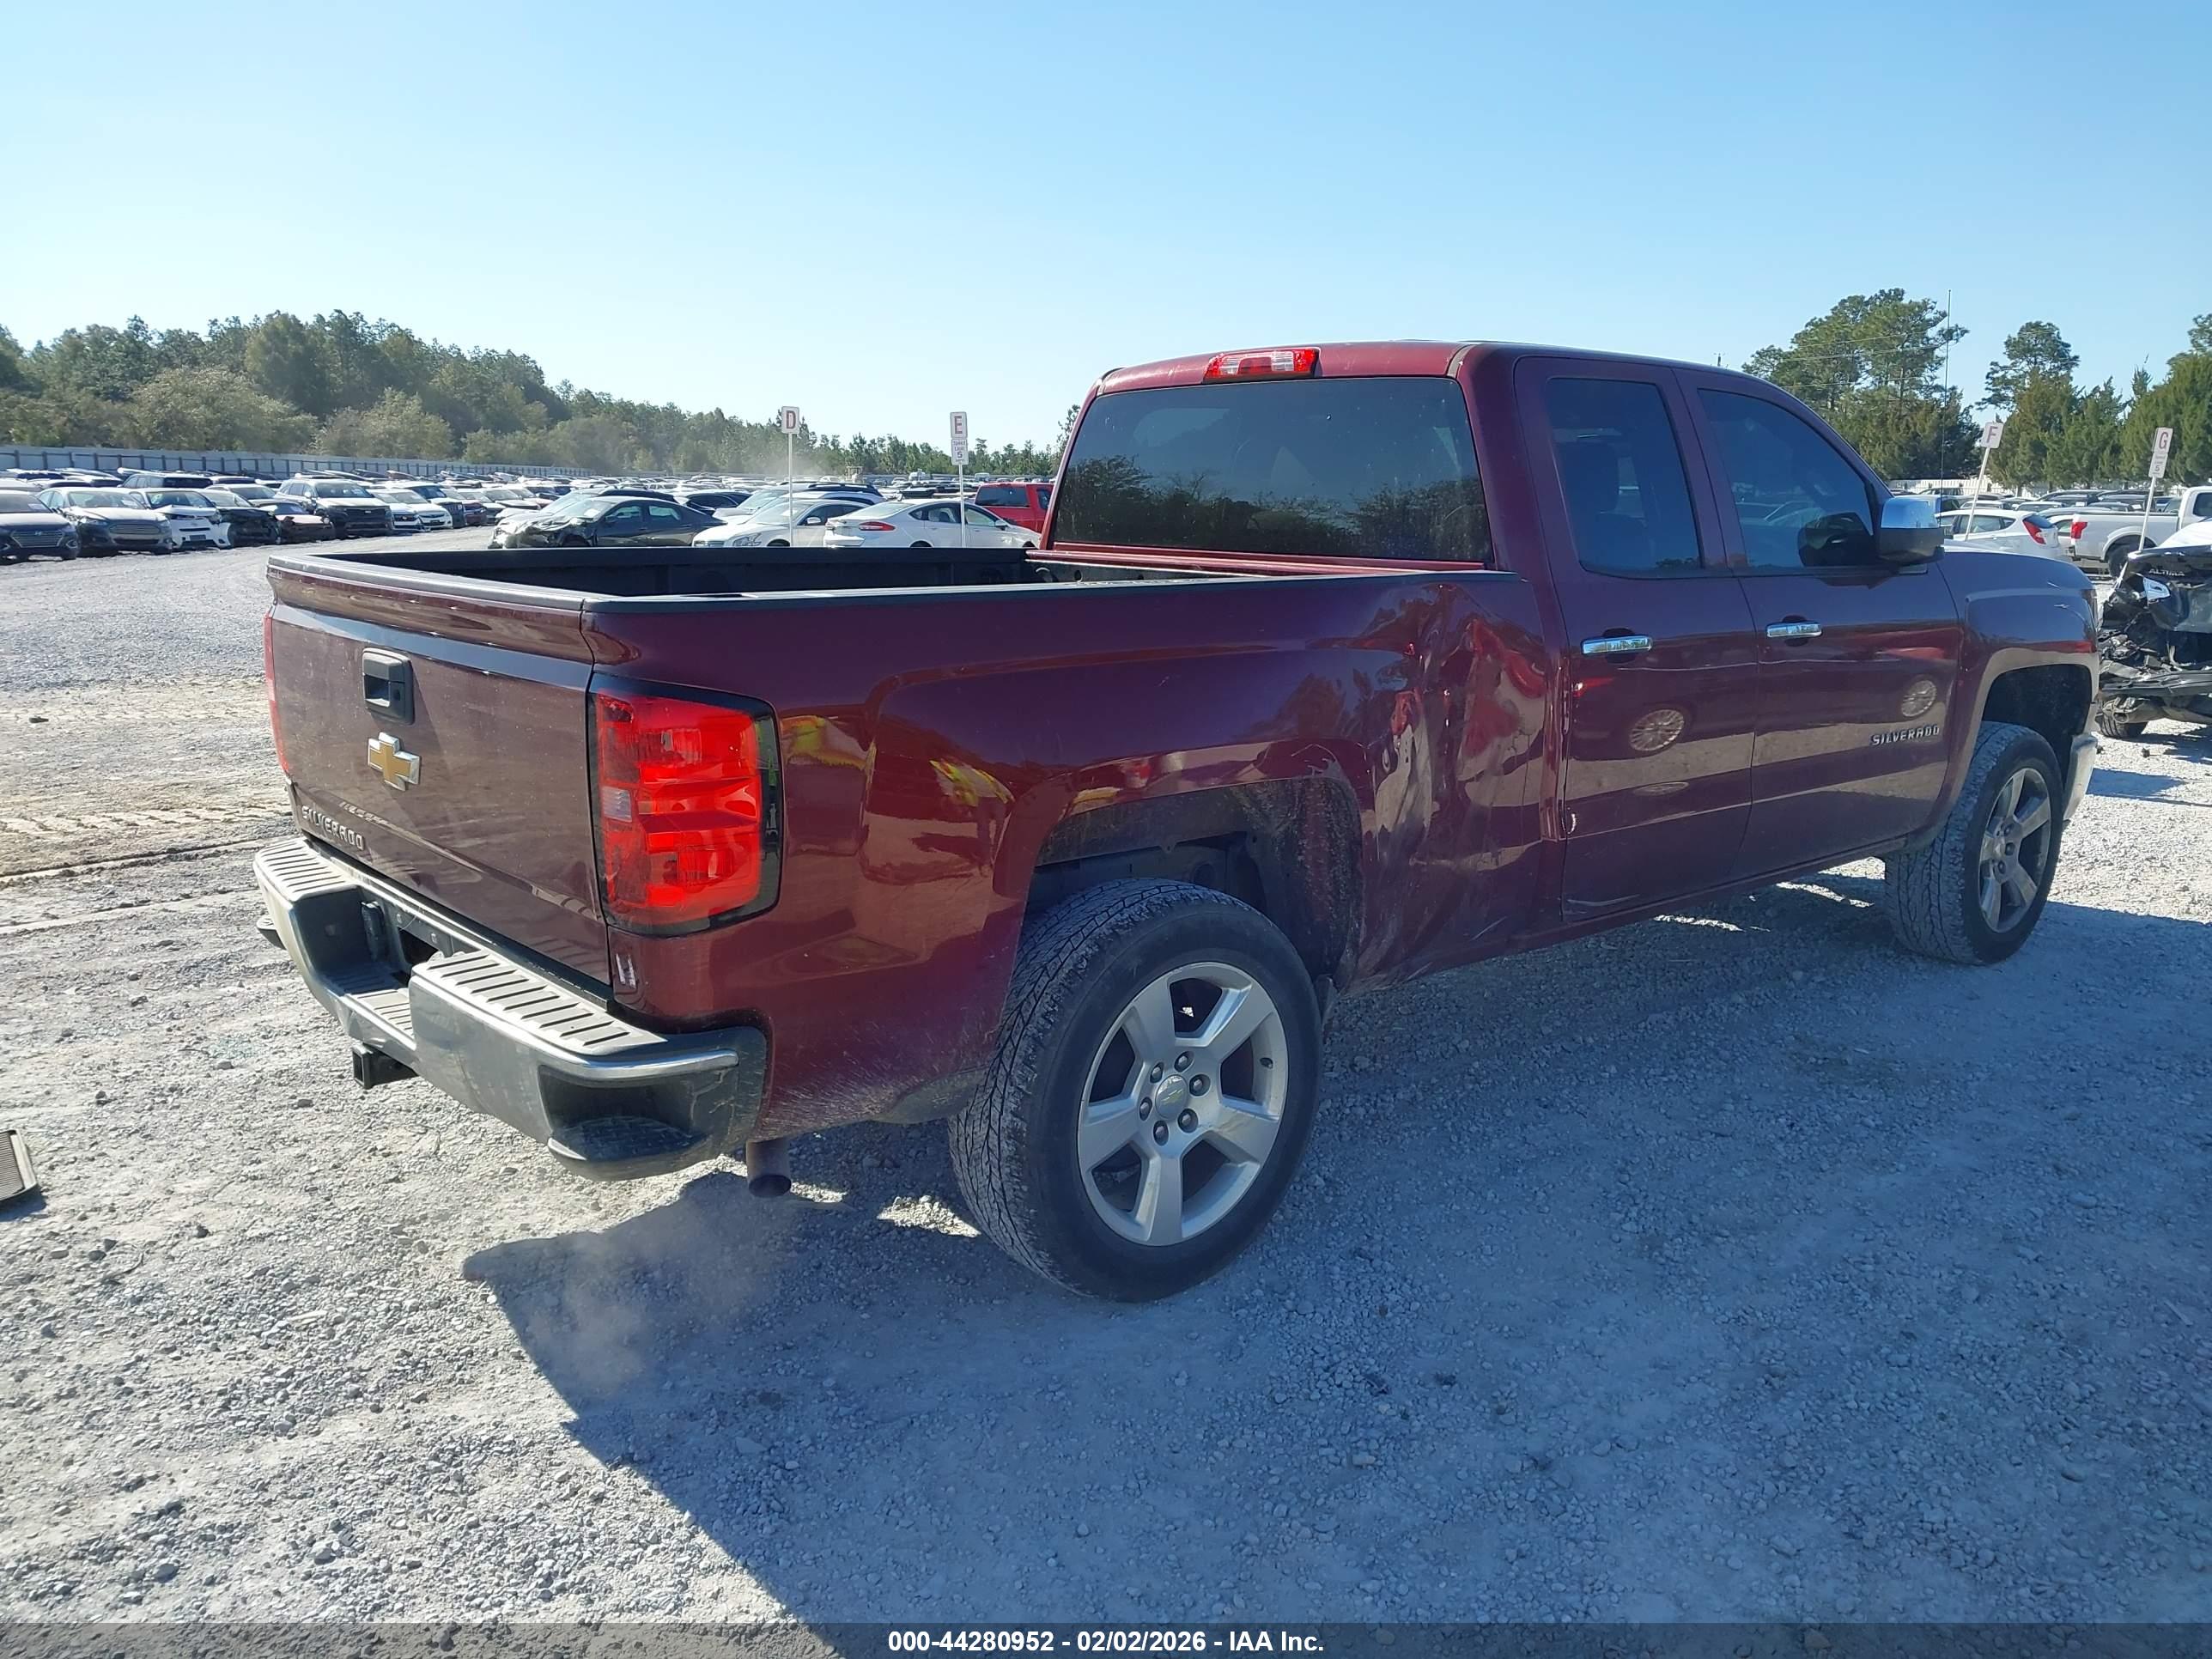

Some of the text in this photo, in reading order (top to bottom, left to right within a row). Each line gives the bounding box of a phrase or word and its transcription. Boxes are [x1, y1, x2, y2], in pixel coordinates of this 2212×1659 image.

[786, 410, 797, 429] D
[954, 415, 963, 434] E
[1986, 425, 1998, 443] F
[2159, 431, 2169, 450] G
[1872, 725, 1940, 746] SILVERADO
[301, 805, 364, 851] SILVERADO
